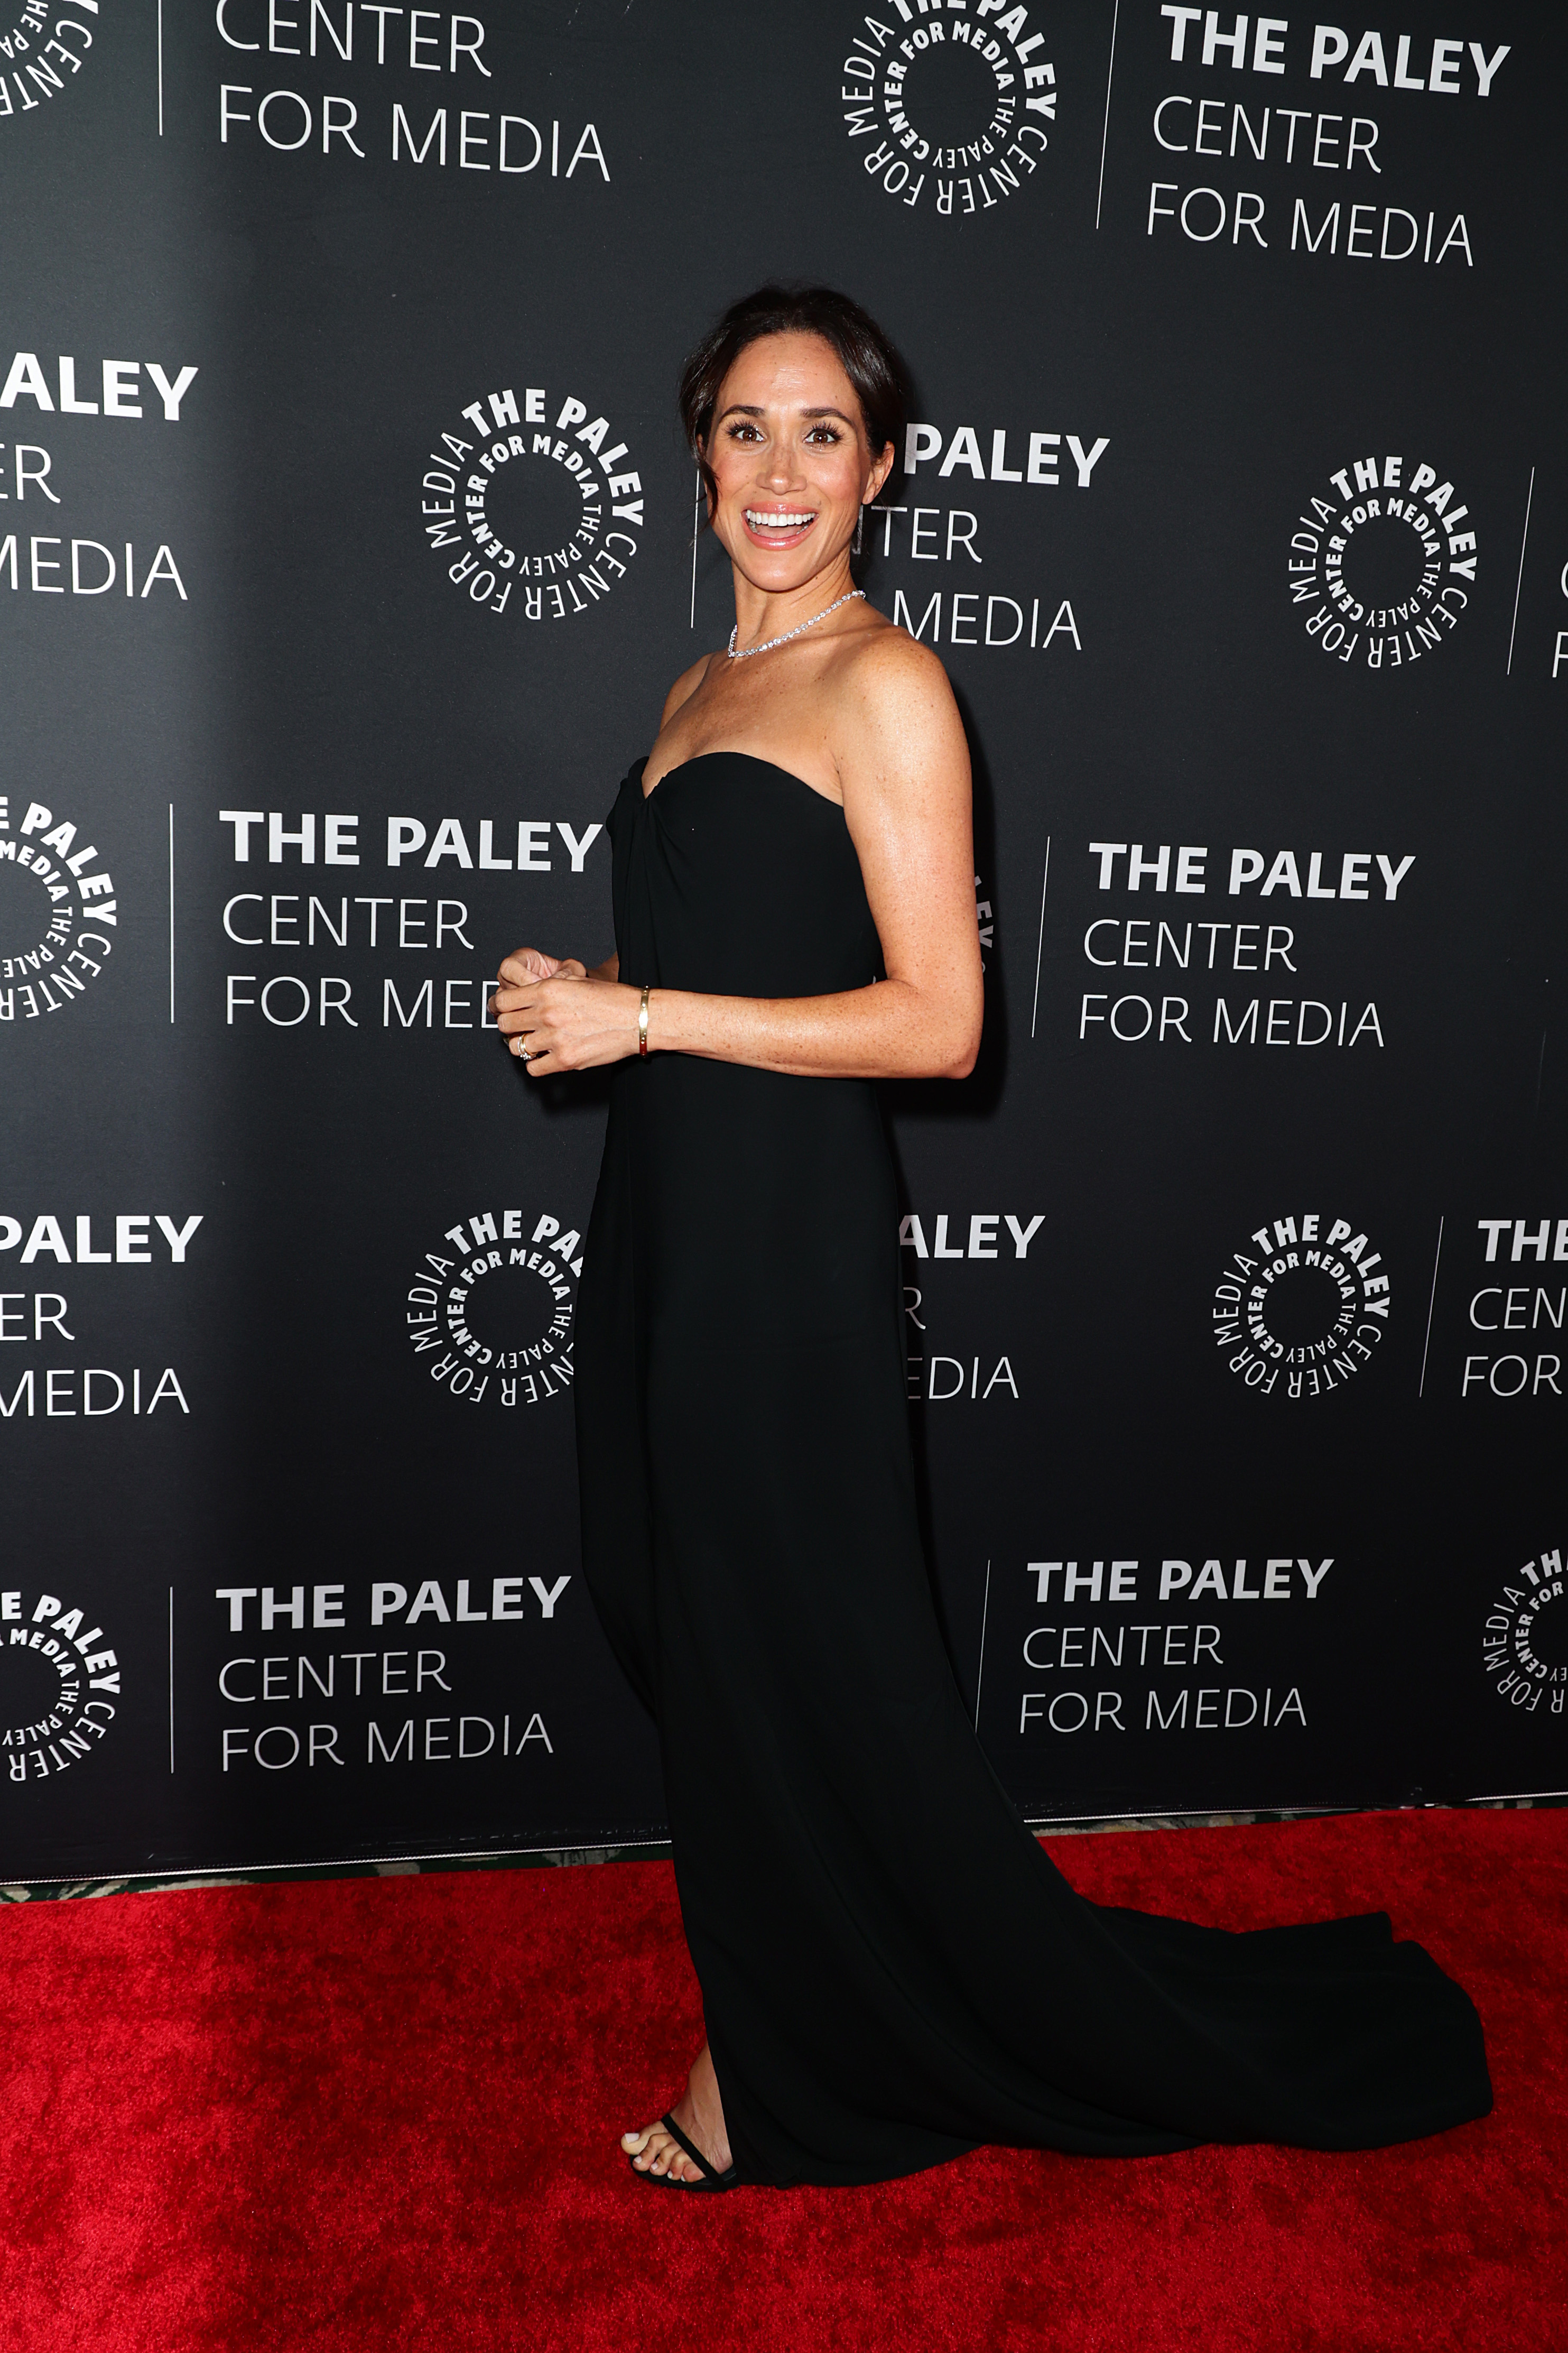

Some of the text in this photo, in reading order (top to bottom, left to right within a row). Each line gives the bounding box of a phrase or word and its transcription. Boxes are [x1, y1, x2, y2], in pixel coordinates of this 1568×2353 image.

[20, 0, 48, 33] HE
[216, 0, 491, 77] CENTER
[899, 22, 945, 60] FOR
[0, 20, 92, 115] CENTE
[842, 16, 895, 136] MEDIA
[952, 21, 1014, 90] MEDIA
[1161, 4, 1511, 96] THE PALEY
[221, 85, 610, 181] FOR MEDIA
[884, 61, 929, 160] CENTER
[989, 96, 1015, 138] THE
[1154, 96, 1381, 173] CENTER
[864, 141, 924, 206] FOR
[933, 135, 994, 169] PALEY
[937, 126, 1047, 214] CENTER
[1148, 182, 1473, 266] FOR MEDIA
[0, 352, 199, 421] ALEY
[904, 423, 1110, 487] PALEY
[422, 389, 644, 620] THE PALEY CENTER FOR MEDIA
[466, 434, 601, 576] THE PALEY CENTER FOR MEDIA
[1288, 456, 1477, 668] THE PALEY CENTER FOR MEDIA
[1325, 497, 1441, 628] THE PALEY CENTER FOR MEDIA
[894, 590, 1081, 650] MEDIA
[219, 810, 603, 872] THE PALEY
[1089, 843, 1416, 900] THE PALEY
[0, 840, 72, 978] THE PALE MEDIA
[0, 802, 116, 1020] PALEY CENTER
[223, 894, 474, 949] CENTER
[1084, 919, 1297, 972] CENTER
[227, 976, 358, 1027] FOR
[1080, 994, 1384, 1047] FOR MEDIA
[444, 1211, 522, 1254] THE
[899, 1215, 1045, 1258] ALEY
[1478, 1220, 1568, 1261] THE
[407, 1254, 455, 1352] MEDIA
[447, 1248, 572, 1369] THE PALEY CENTER FOR MEDIA
[1213, 1215, 1390, 1397] THE PALEY CENTER FOR MEDIA
[1248, 1250, 1356, 1363] THE PALEY CENTER FOR MEDIA
[1470, 1288, 1566, 1330] CEN
[431, 1353, 488, 1402] FOR
[502, 1343, 573, 1406] NTER
[1462, 1355, 1562, 1397] FOR
[216, 1576, 571, 1631] THE PALEY
[1027, 1560, 1334, 1602] THE PALEY
[1024, 1626, 1223, 1668] CENTER
[1483, 1547, 1568, 1711] TH FOR MEDIA
[1515, 1582, 1563, 1678] CENTER FOR
[2, 1629, 79, 1746] THE PALEY MEDIA
[9, 1594, 120, 1781] PALEY CENTER
[219, 1650, 451, 1702] CENTER
[223, 1714, 553, 1771] FOR MEDIA
[1020, 1688, 1306, 1733] FOR MEDIA
